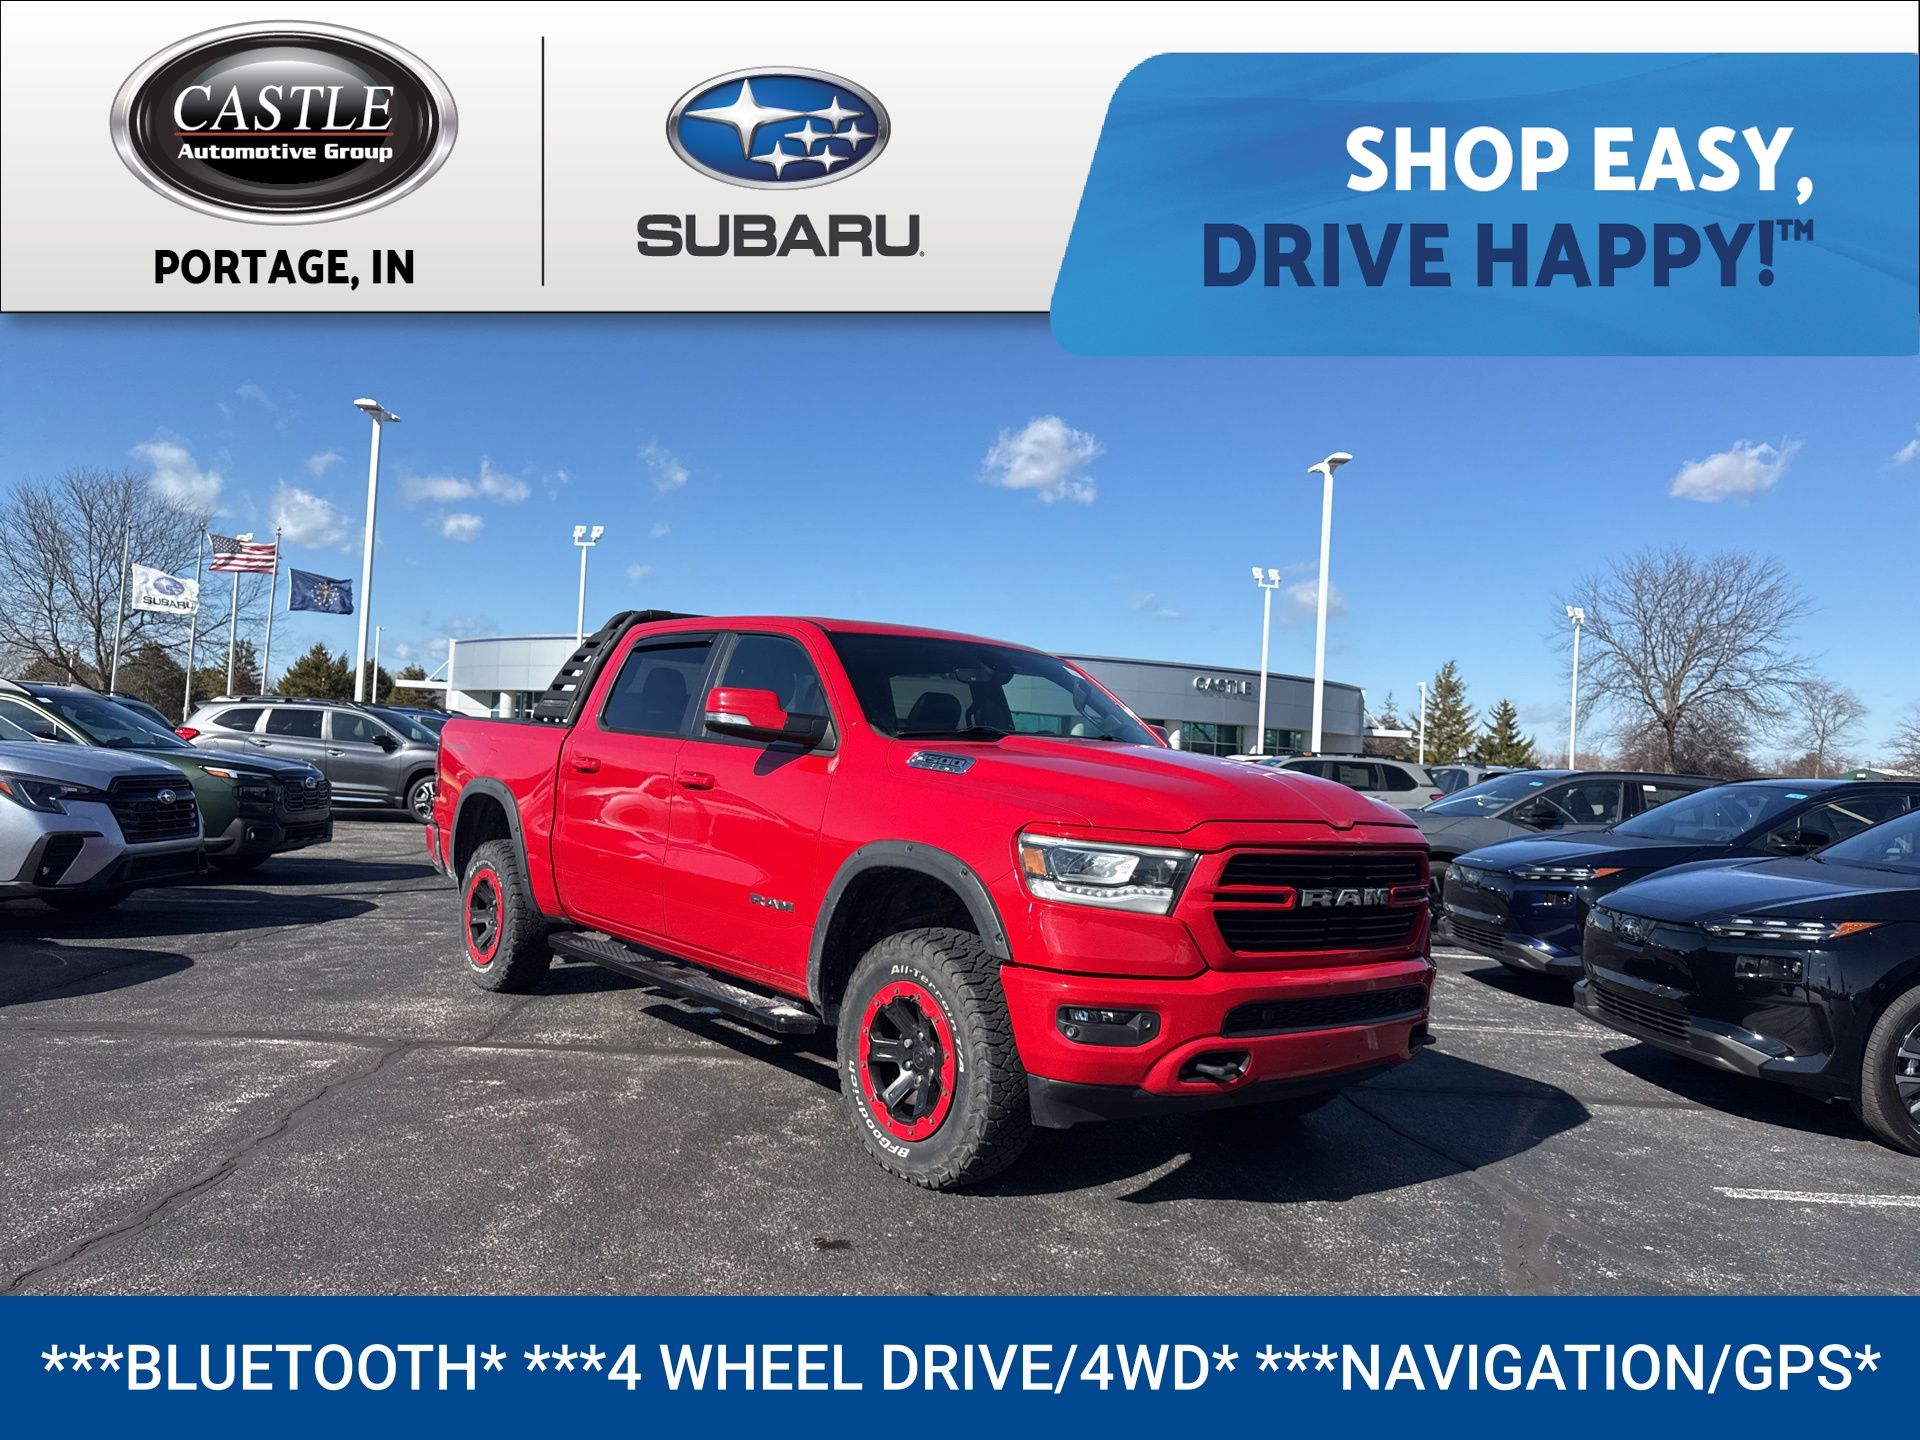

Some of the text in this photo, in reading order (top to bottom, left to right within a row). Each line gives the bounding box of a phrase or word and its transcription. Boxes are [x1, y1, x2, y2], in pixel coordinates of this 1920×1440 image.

[143, 595, 194, 610] SUBARU
[1192, 676, 1252, 695] CASTLE
[750, 893, 795, 912] RAM
[1301, 888, 1390, 907] RAM
[891, 964, 957, 1031] All-Terrain
[848, 1059, 910, 1158] BFGoodrich
